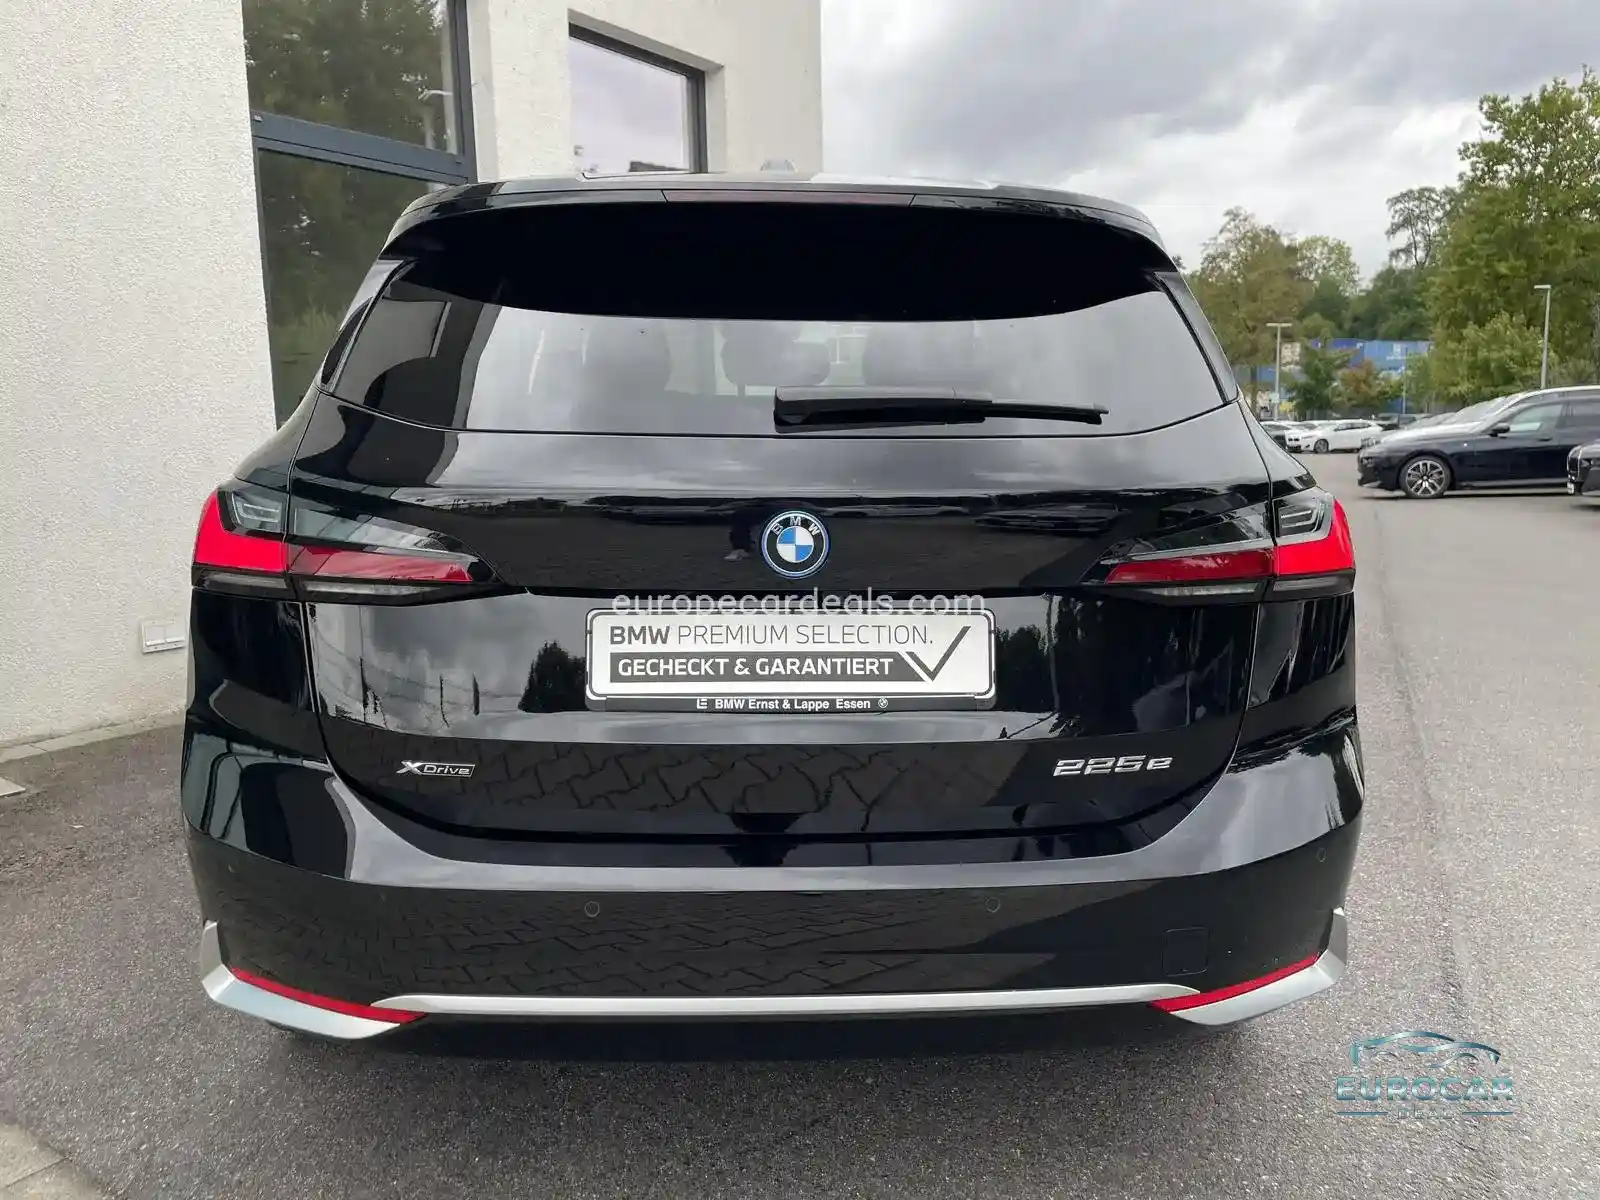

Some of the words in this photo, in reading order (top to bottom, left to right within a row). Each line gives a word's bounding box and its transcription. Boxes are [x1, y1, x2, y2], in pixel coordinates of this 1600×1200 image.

[770, 515, 821, 536] BMW
[610, 625, 670, 645] BMW
[678, 624, 788, 645] PREMIUM
[796, 624, 933, 645] SELECTION.
[618, 658, 730, 676] GECHECKT
[734, 658, 750, 676] &
[755, 658, 893, 676] GARANTIERT
[715, 698, 744, 709] BMW
[748, 698, 779, 709] Ernst
[782, 699, 791, 709] &
[794, 698, 829, 712] Lappe
[836, 698, 871, 709] Essen
[1053, 755, 1173, 776] 225e
